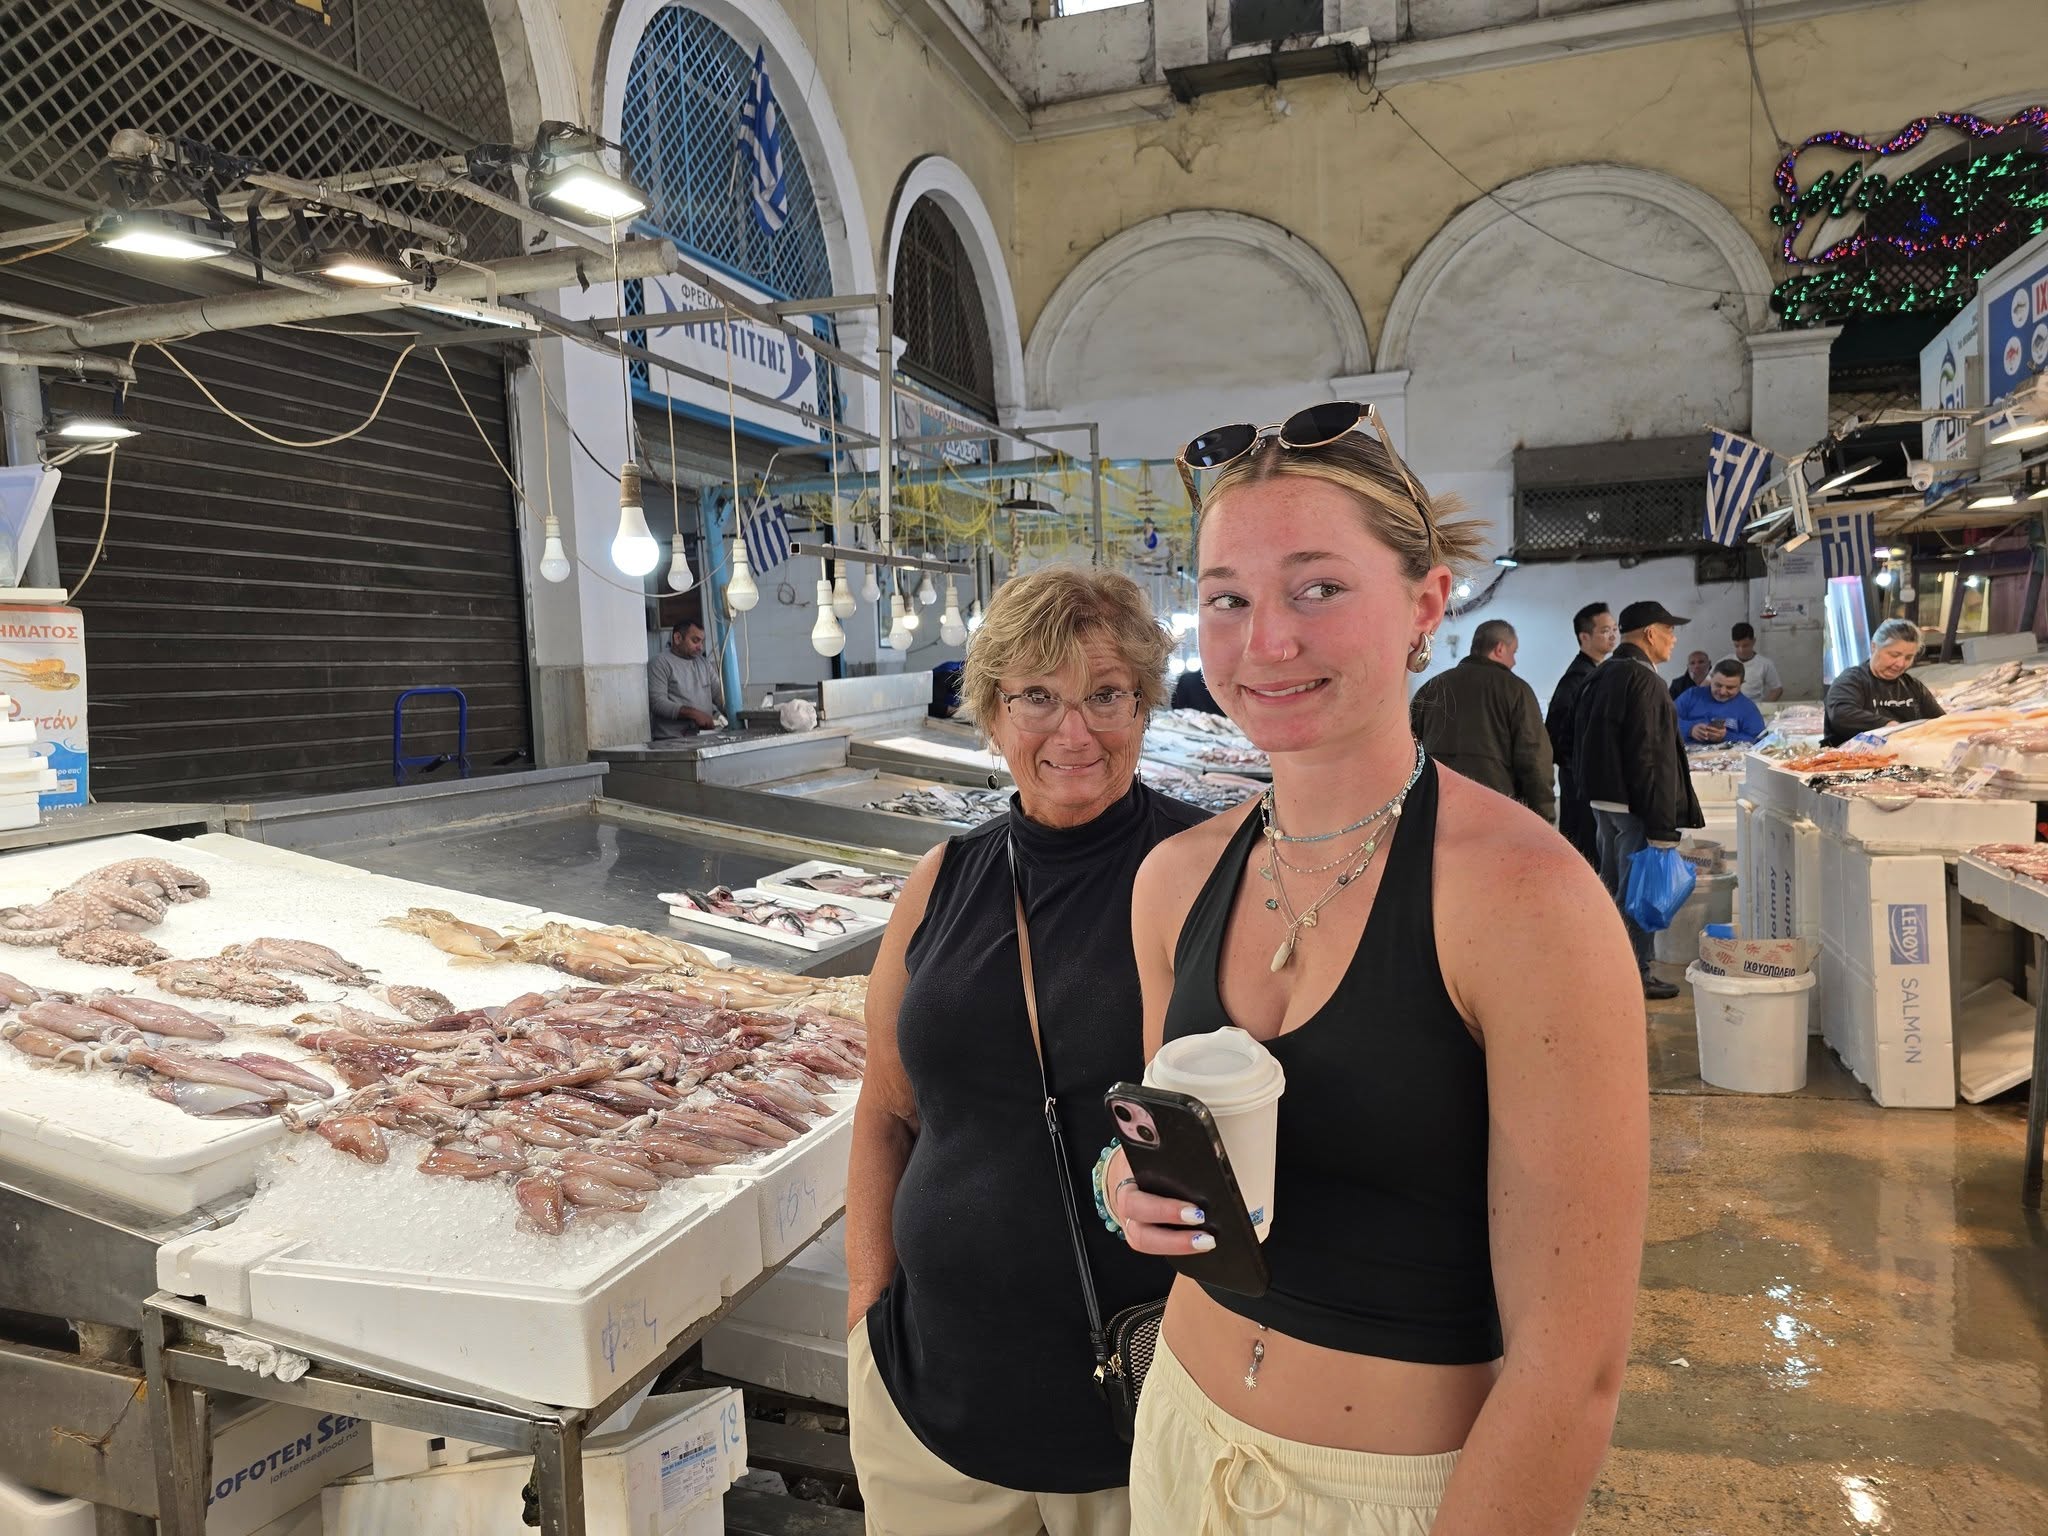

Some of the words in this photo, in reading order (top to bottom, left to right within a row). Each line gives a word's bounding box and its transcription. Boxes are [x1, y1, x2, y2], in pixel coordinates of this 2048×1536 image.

[1901, 908, 1921, 963] LERØY
[1743, 960, 1796, 977] ΙΧΘΥΟΠΩΛΕΙΟ
[270, 1430, 359, 1485] lofotenseafood.no
